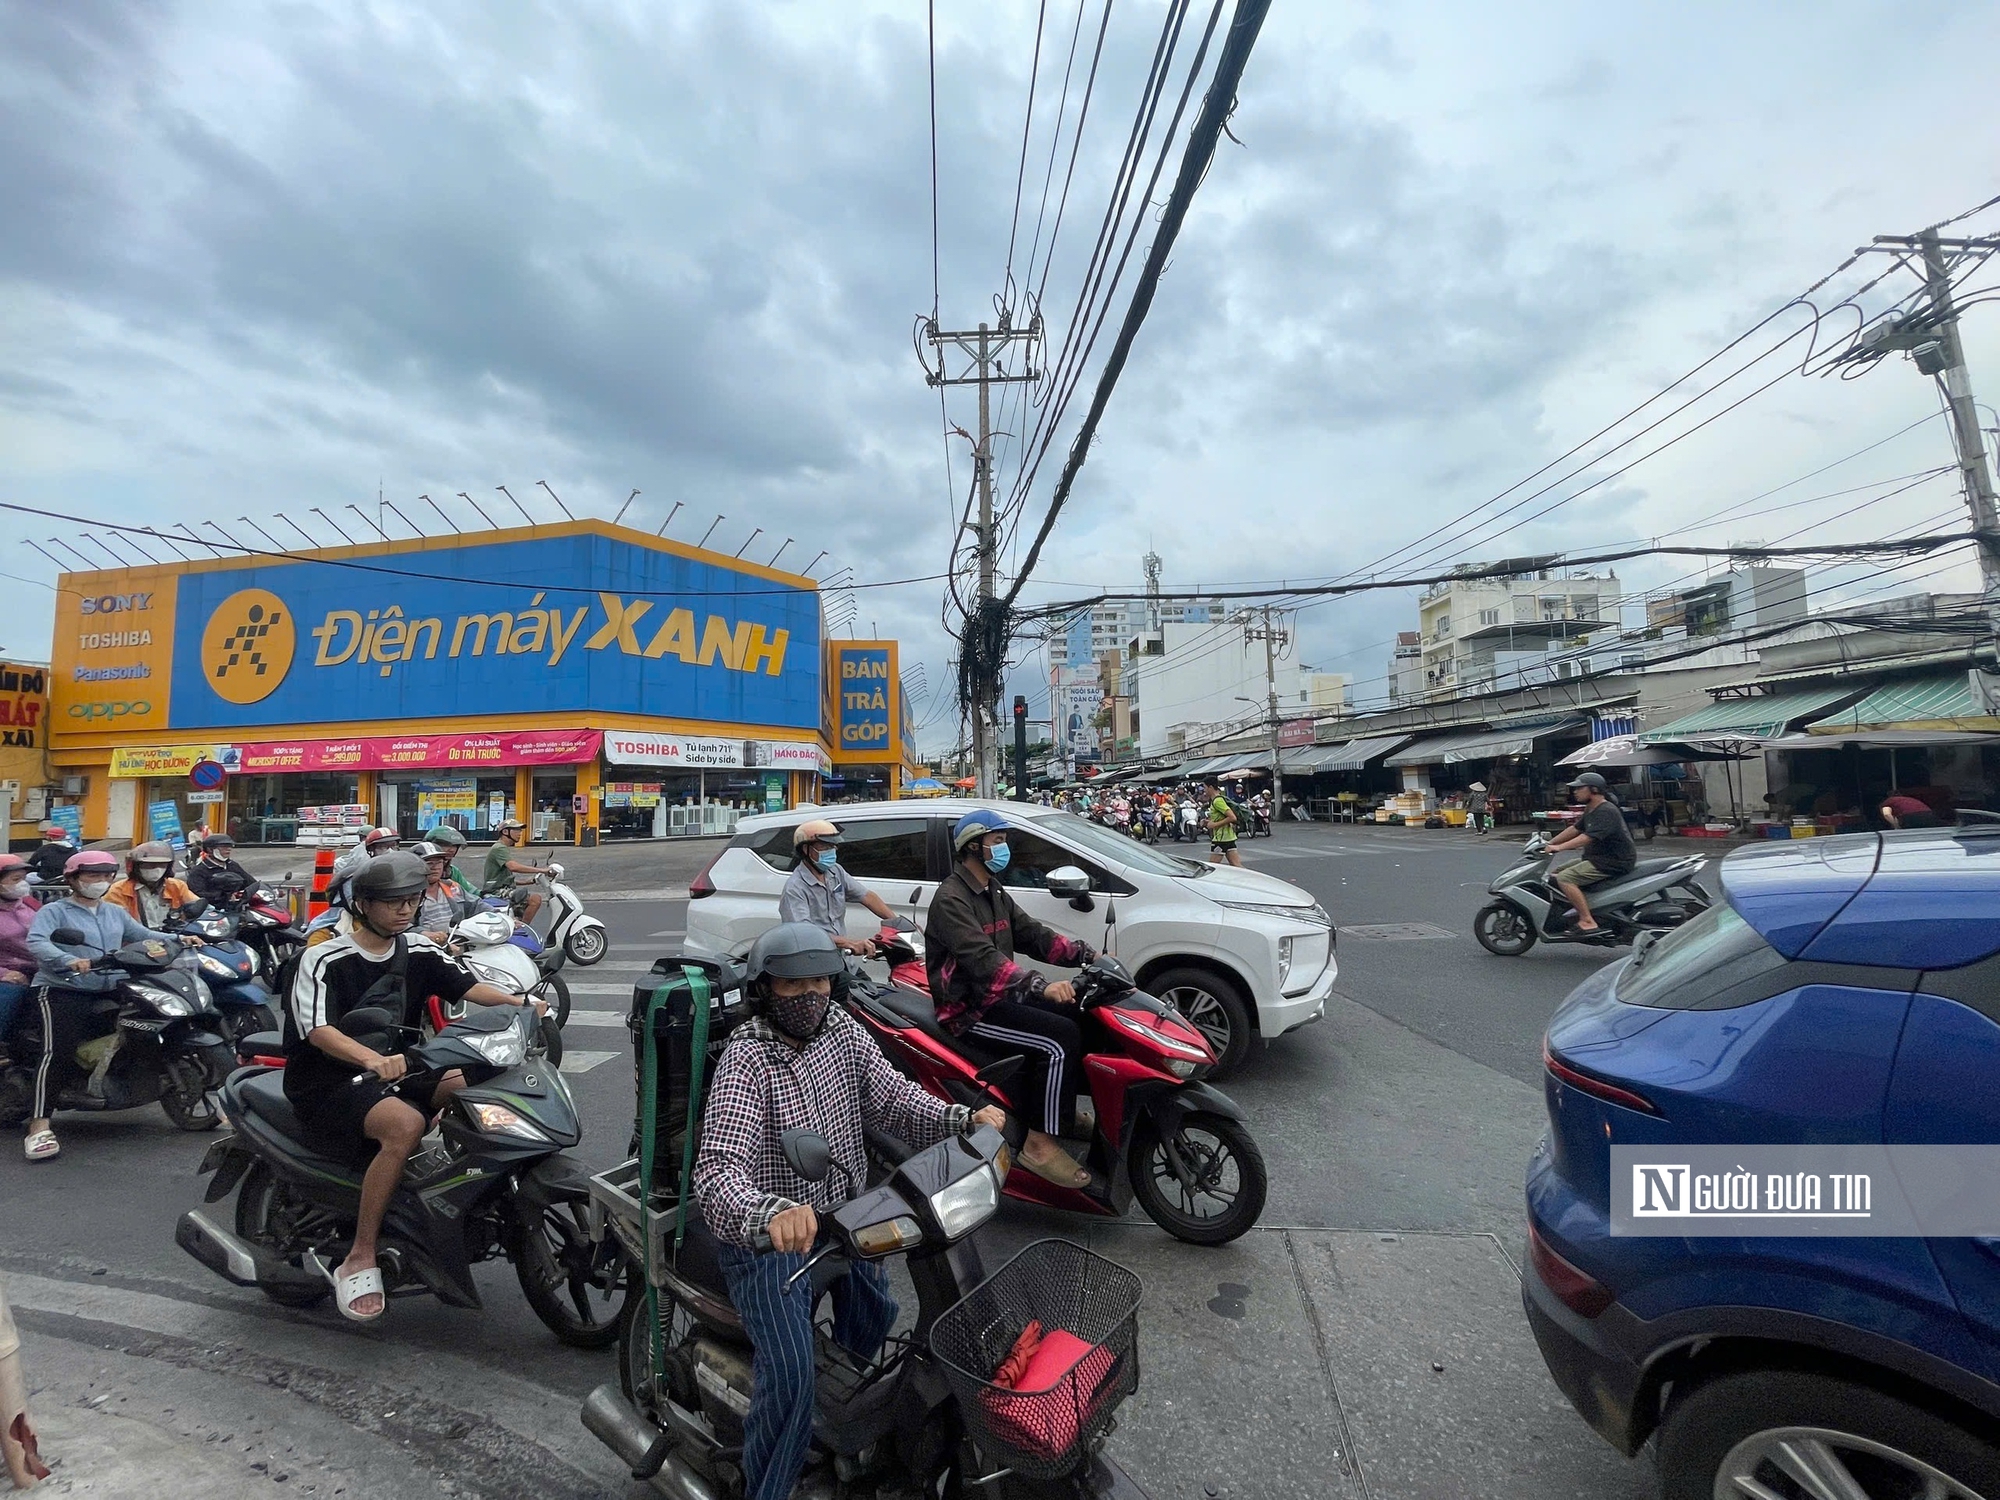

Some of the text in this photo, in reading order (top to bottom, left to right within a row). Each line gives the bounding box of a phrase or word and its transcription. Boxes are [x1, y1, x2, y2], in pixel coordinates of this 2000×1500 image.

[81, 593, 153, 614] SONY
[80, 629, 153, 650] TOSHIBA
[312, 592, 789, 677] Điện máy XANH
[74, 661, 152, 683] Panasonic
[842, 657, 888, 679] BÁN
[843, 686, 887, 710] TRẢ
[842, 719, 888, 742] GÓP
[461, 747, 475, 760] TRẢ
[615, 741, 679, 757] TOSHIBA
[685, 743, 697, 752] Tủ
[698, 743, 717, 753] lạnh
[685, 754, 736, 764] Side by side
